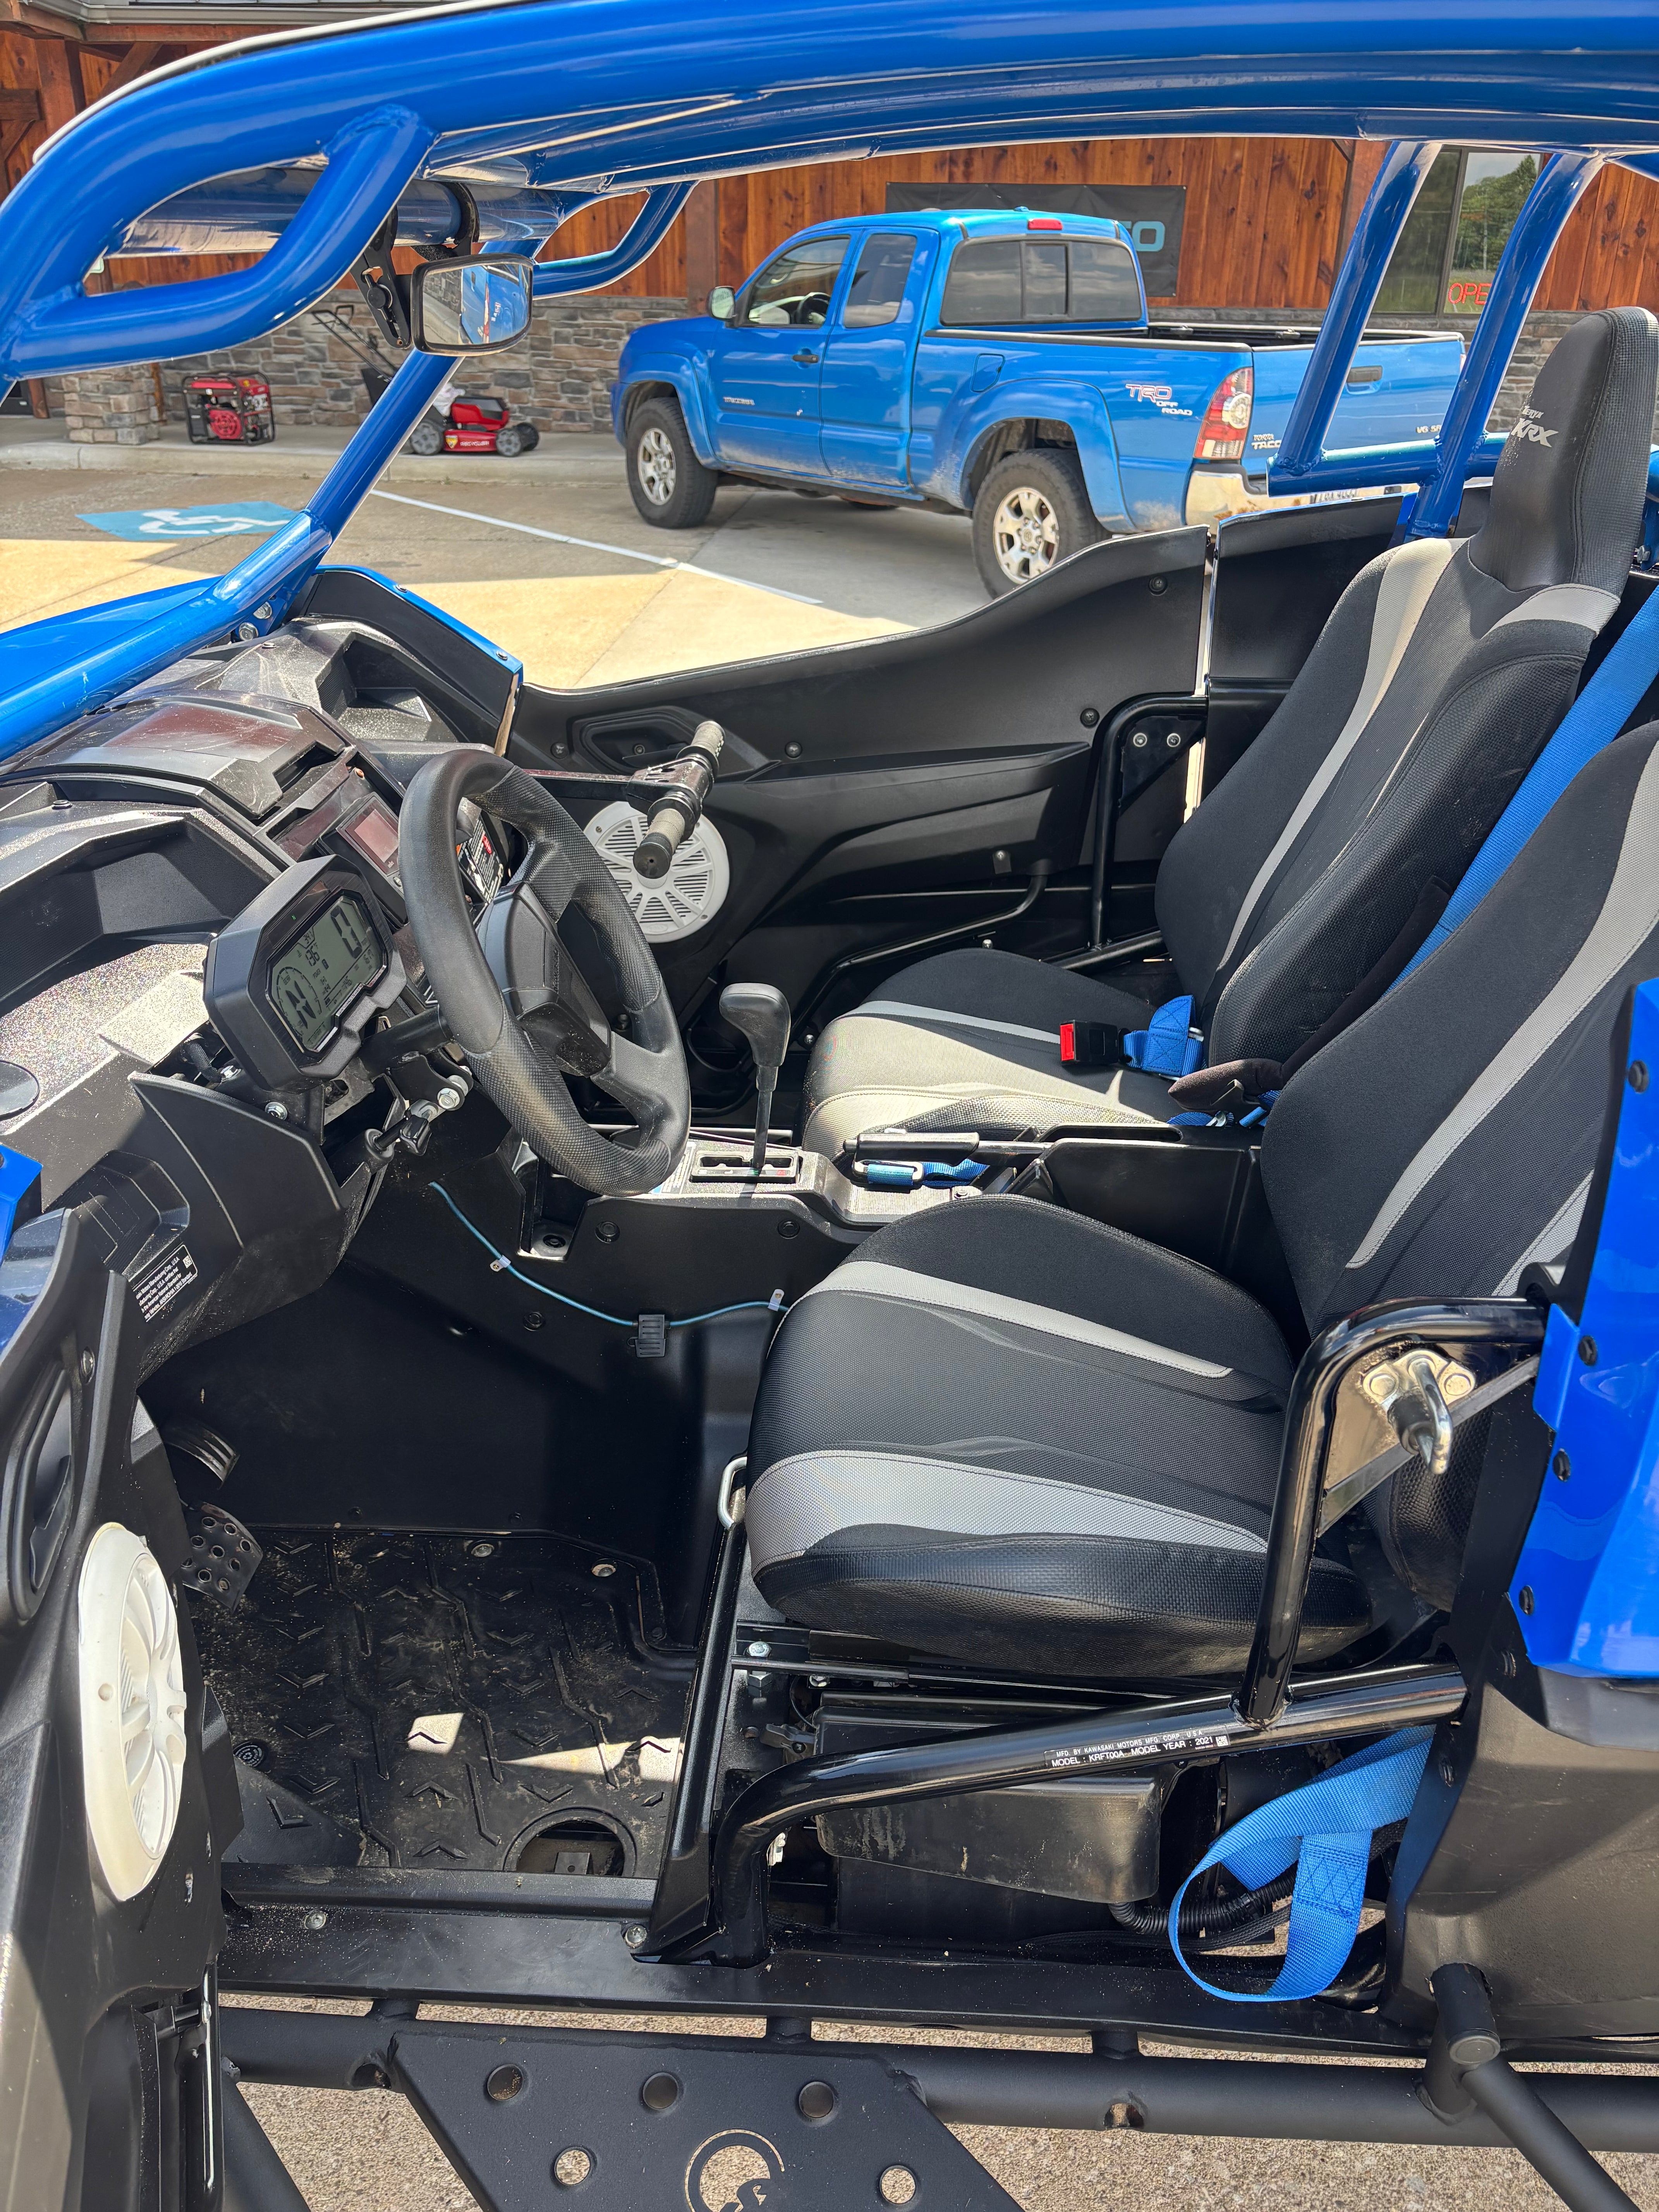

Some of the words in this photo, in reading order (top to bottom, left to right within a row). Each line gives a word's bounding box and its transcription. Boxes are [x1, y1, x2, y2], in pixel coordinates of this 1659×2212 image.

[1448, 283, 1492, 305] OPE
[1125, 384, 1172, 402] TRD
[1511, 418, 1559, 447] KRX
[1052, 1757, 1080, 1767] MODEL
[1089, 1750, 1125, 1762] KRFT00A
[1131, 1746, 1161, 1756] MODEL
[1163, 1741, 1186, 1750] YEAR
[1195, 1736, 1213, 1745] 2021
[1084, 1743, 1114, 1753] KAWASAKI
[1117, 1739, 1142, 1748] MOTORS
